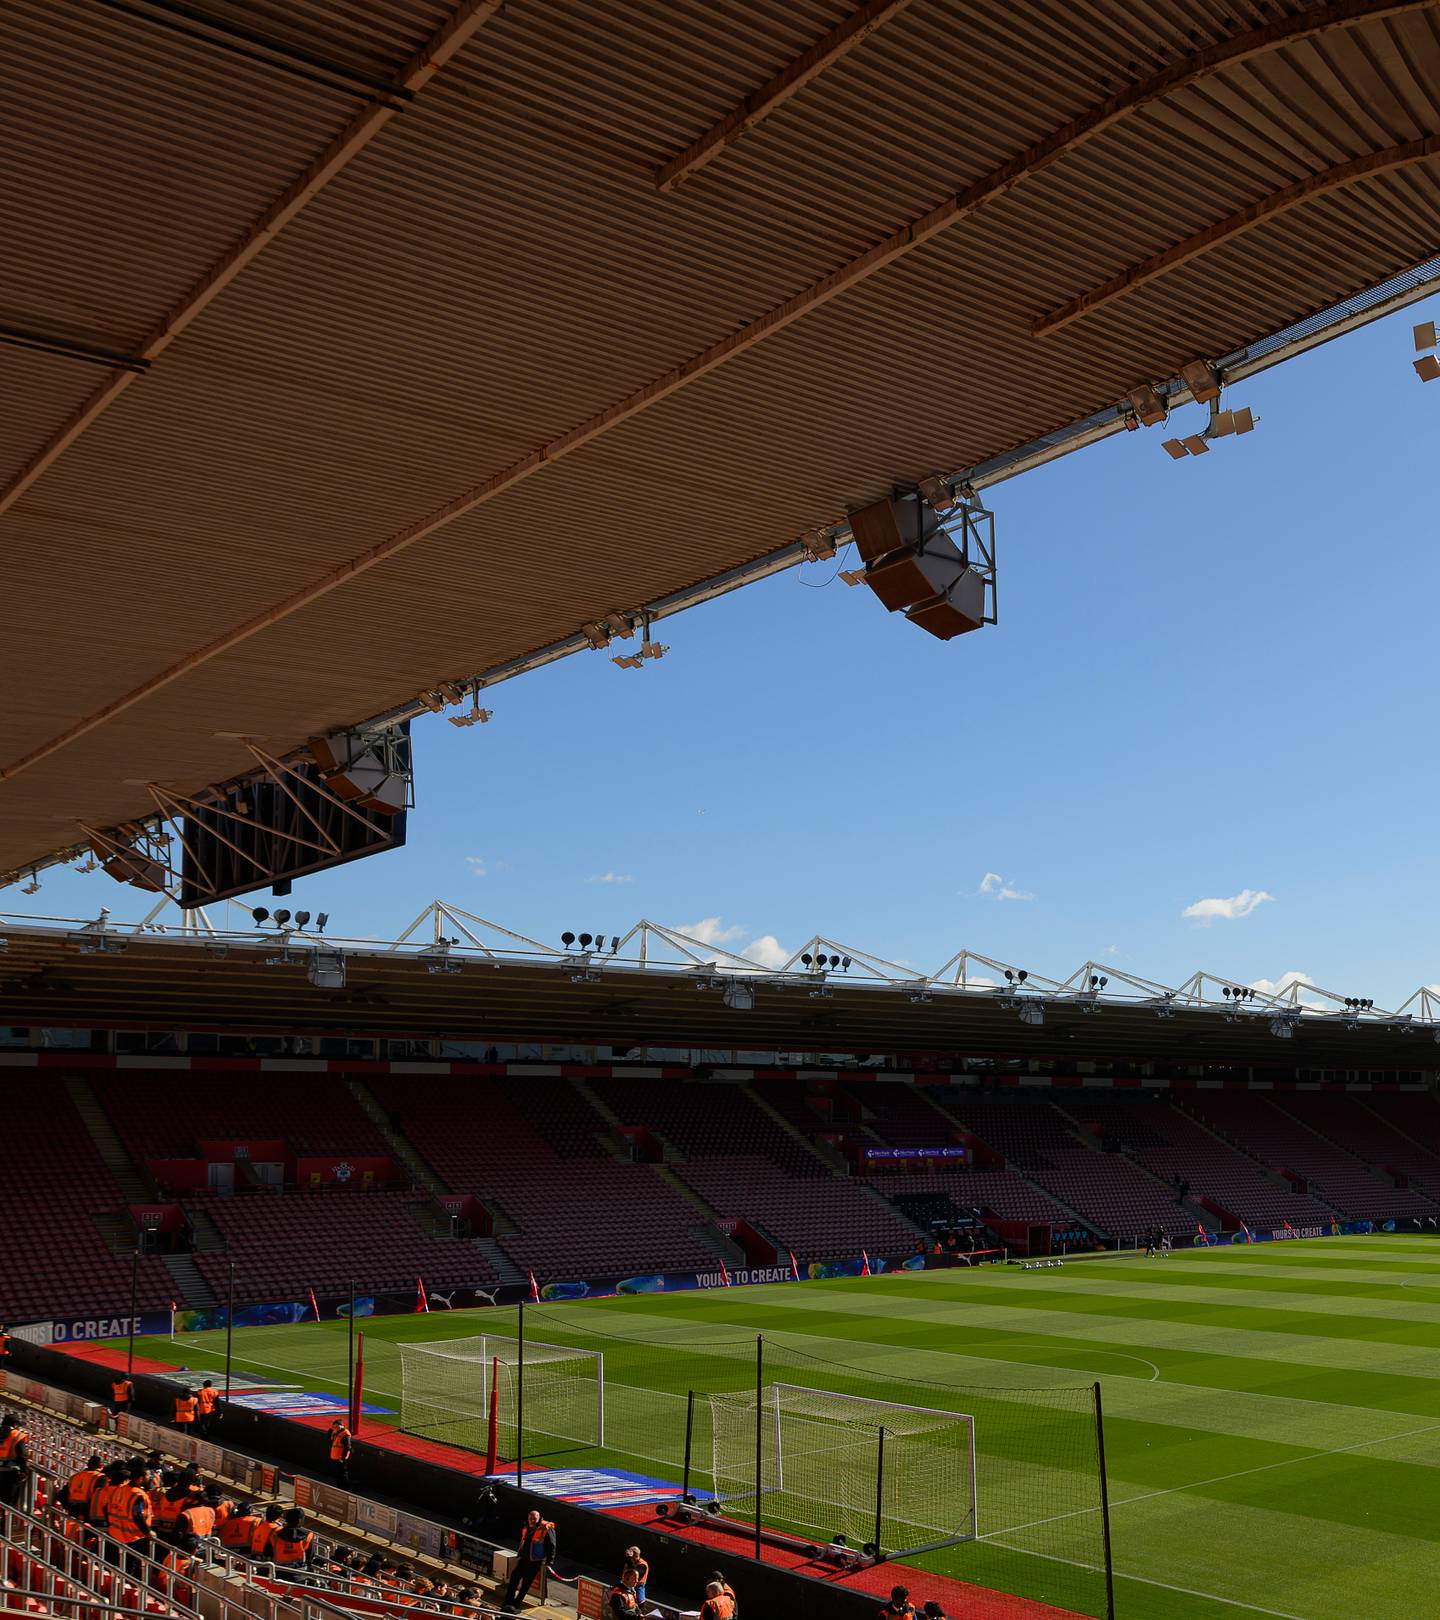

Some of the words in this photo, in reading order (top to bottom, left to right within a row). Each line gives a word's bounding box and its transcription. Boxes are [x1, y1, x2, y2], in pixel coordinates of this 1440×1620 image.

[1272, 1230, 1292, 1240] YOURS
[1301, 1227, 1323, 1238] CREATE
[734, 1271, 749, 1284] TO
[751, 1267, 791, 1284] CREATE
[51, 1324, 66, 1341] TO
[72, 1317, 142, 1340] CREATE
